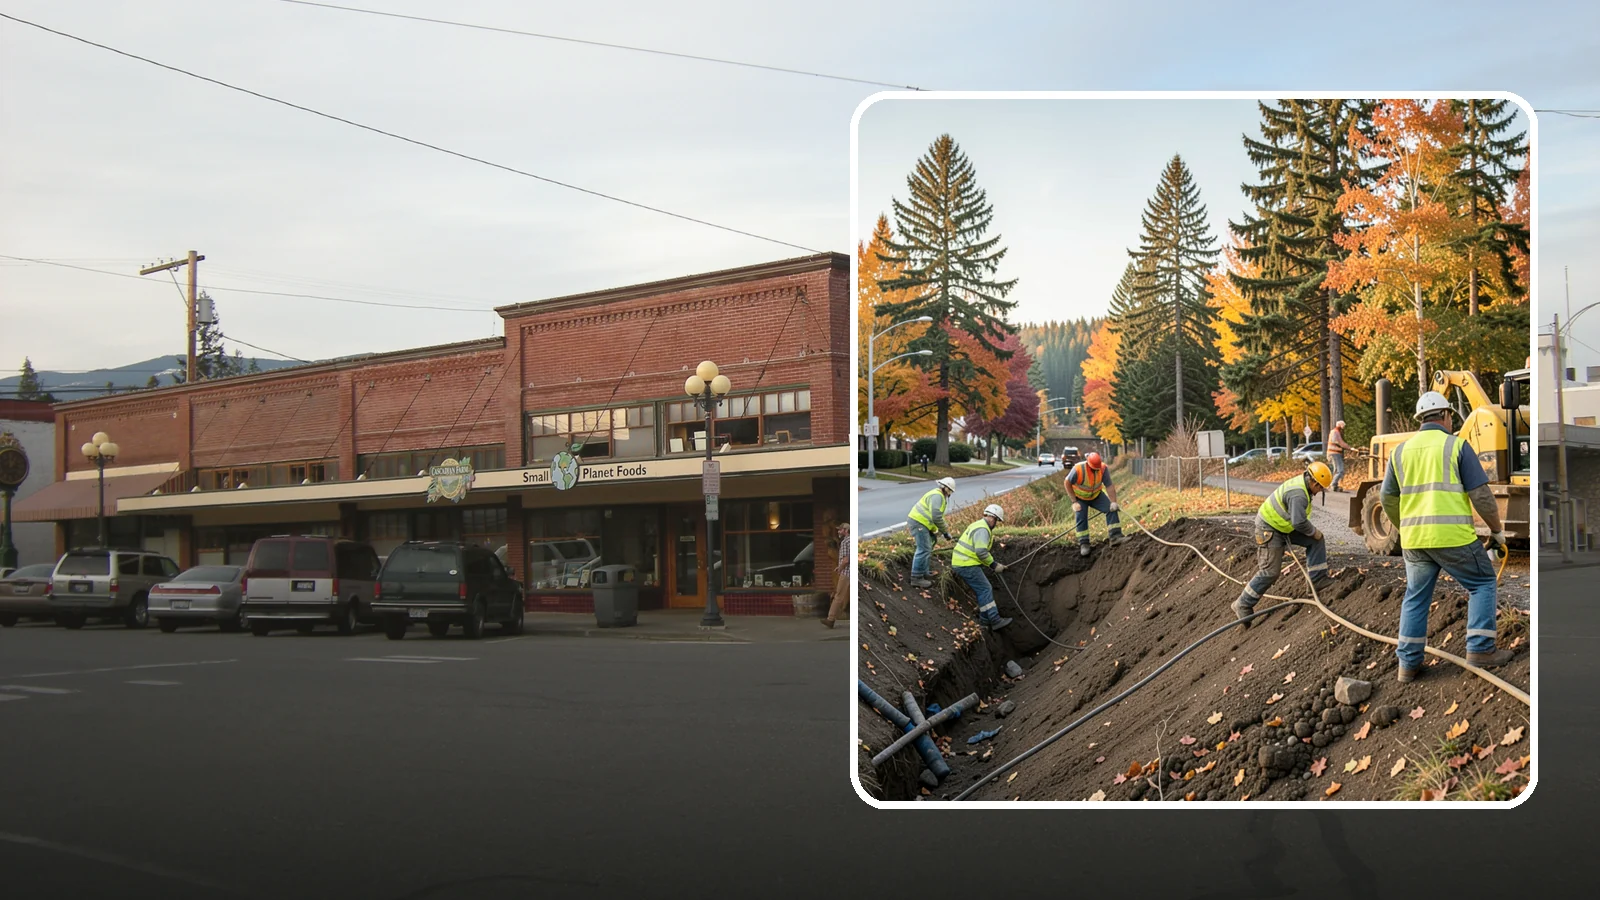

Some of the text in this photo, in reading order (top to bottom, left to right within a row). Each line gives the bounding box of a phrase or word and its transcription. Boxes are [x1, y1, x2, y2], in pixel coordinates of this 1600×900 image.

[523, 464, 647, 483] Small Planet Foods
